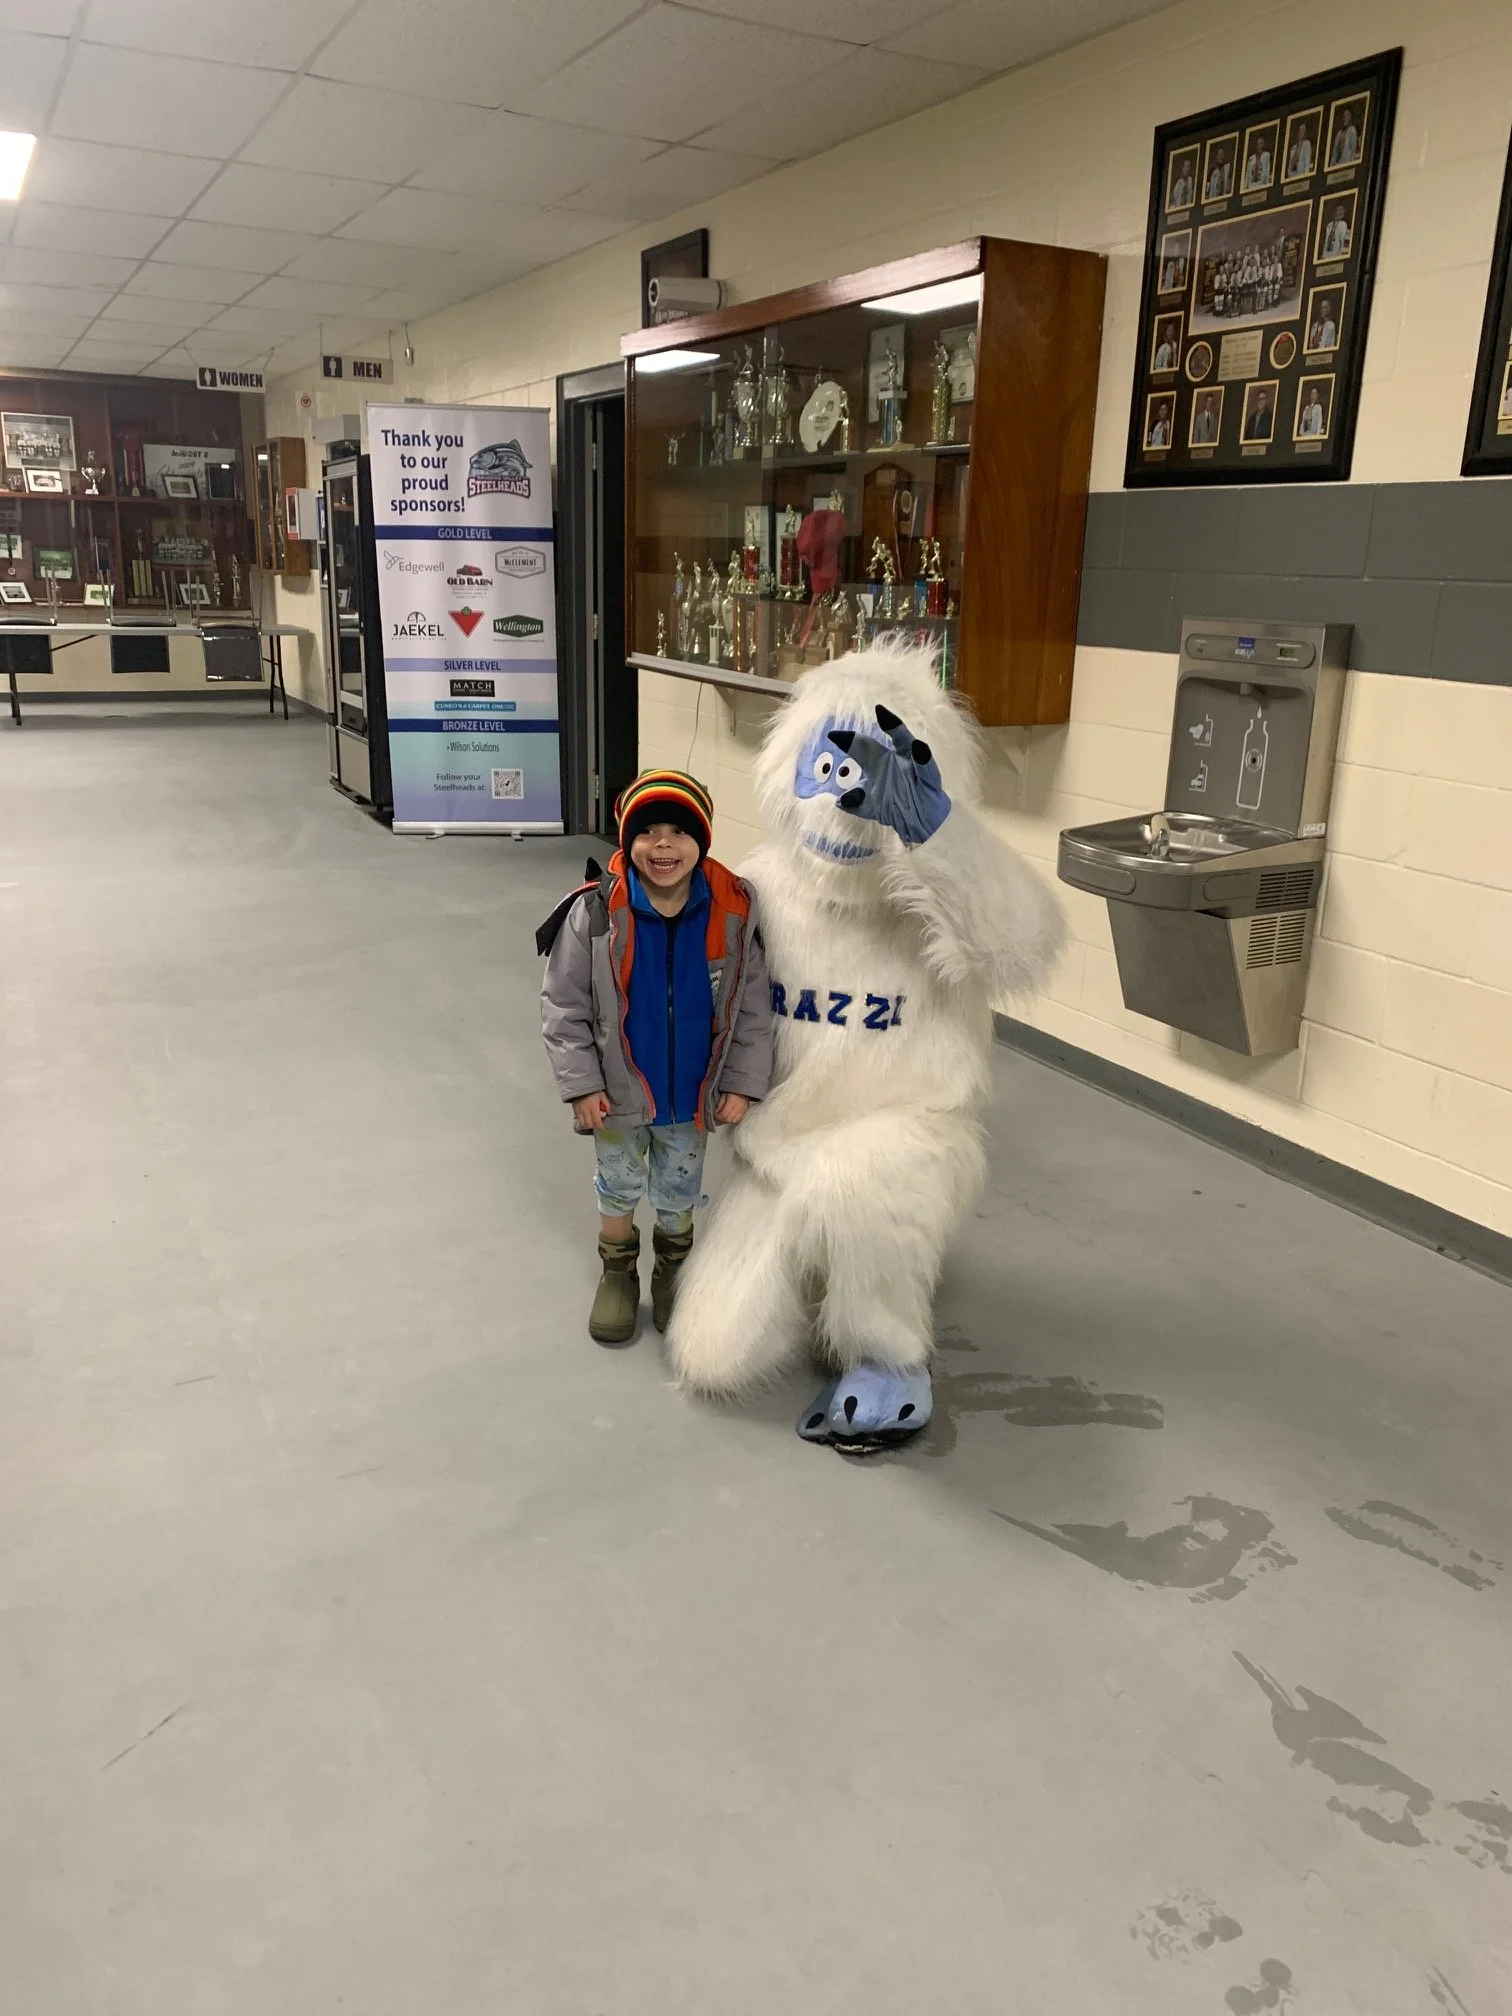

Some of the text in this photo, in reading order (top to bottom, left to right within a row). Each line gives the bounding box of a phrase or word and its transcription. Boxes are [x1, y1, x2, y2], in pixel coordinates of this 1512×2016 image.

[353, 361, 382, 378] MEN
[219, 371, 263, 388] WOMEN
[381, 428, 464, 452] Thank you
[400, 453, 448, 469] to our
[401, 473, 449, 494] proud
[469, 478, 529, 497] STEELHEADS
[390, 496, 465, 516] sponsors!
[438, 527, 492, 540] GOLD LEVEL
[399, 562, 444, 575] Edgewell
[446, 577, 494, 587] OLD BARN
[393, 624, 444, 637] JAEKEL
[495, 621, 541, 633] Wellington
[444, 661, 501, 671] SILVER LEVEL
[442, 721, 506, 731] BRONZE LEVEL
[450, 741, 500, 752] Wilson Solutions
[463, 774, 481, 782] your
[433, 783, 476, 791] Steelheads
